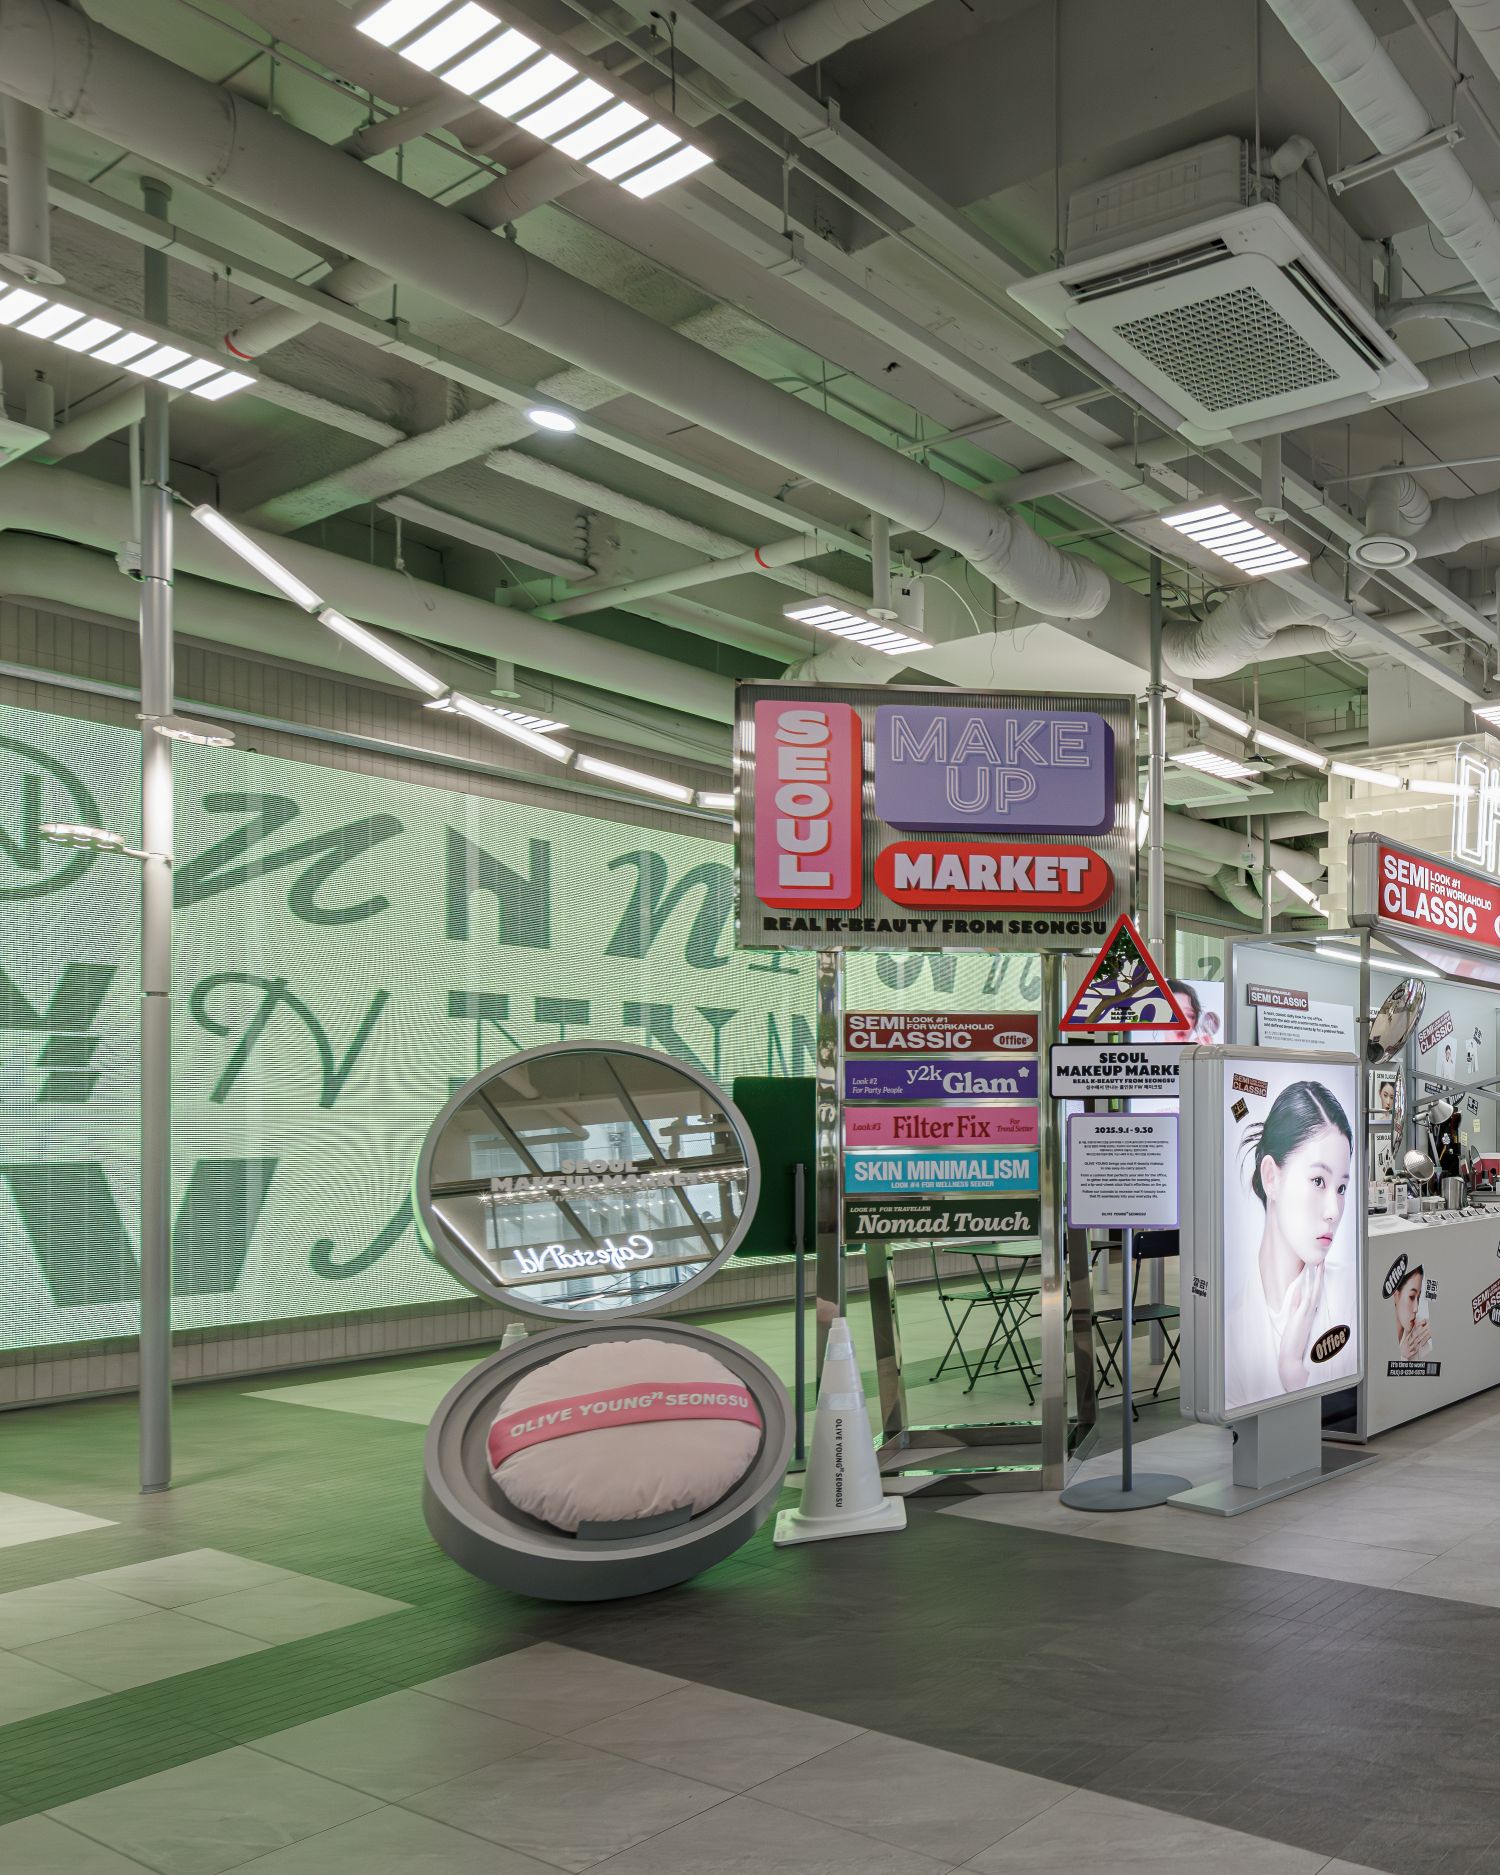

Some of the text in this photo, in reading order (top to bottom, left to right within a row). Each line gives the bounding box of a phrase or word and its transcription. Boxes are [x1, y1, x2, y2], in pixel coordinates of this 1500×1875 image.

[890, 715, 1090, 767] MAKE
[775, 710, 830, 888] SEOUL
[946, 765, 1038, 814] UP
[894, 853, 1089, 892] MARKET
[1384, 854, 1429, 889] SEMI
[1430, 870, 1461, 889] LOOK #1
[1430, 884, 1446, 896] FOR
[1384, 883, 1477, 933] CLASSIC
[764, 916, 1106, 936] REAL K-BEAUTY FROM SEONGSU
[1251, 992, 1307, 1008] SEMI CLASSIC
[850, 1016, 905, 1030] SEMI
[849, 1032, 972, 1049] CLASSIC
[1000, 1035, 1028, 1045] Office
[1418, 1025, 1434, 1042] SEMI
[1420, 1022, 1453, 1052] CLASSIC
[1100, 1053, 1148, 1063] SEOUL
[906, 1065, 1018, 1094] y2k Glam
[1057, 1065, 1179, 1076] MAKEUP MARKE
[1234, 1075, 1250, 1084] SEMI
[864, 1087, 881, 1095] Party
[883, 1087, 903, 1095] People
[1234, 1082, 1266, 1097] CLASSIC
[893, 1115, 991, 1139] Filter Fix
[561, 1160, 638, 1174] SEOUL
[855, 1160, 1030, 1181] SKIN MINIMALISM
[604, 1173, 700, 1188] MARKET
[856, 1212, 1030, 1234] Nomad Touch
[1385, 1261, 1406, 1294] Office
[1472, 1290, 1490, 1310] SEMI
[1316, 1332, 1346, 1360] Office
[510, 1408, 572, 1438] OLIVE
[665, 1394, 749, 1408] SEONGSU
